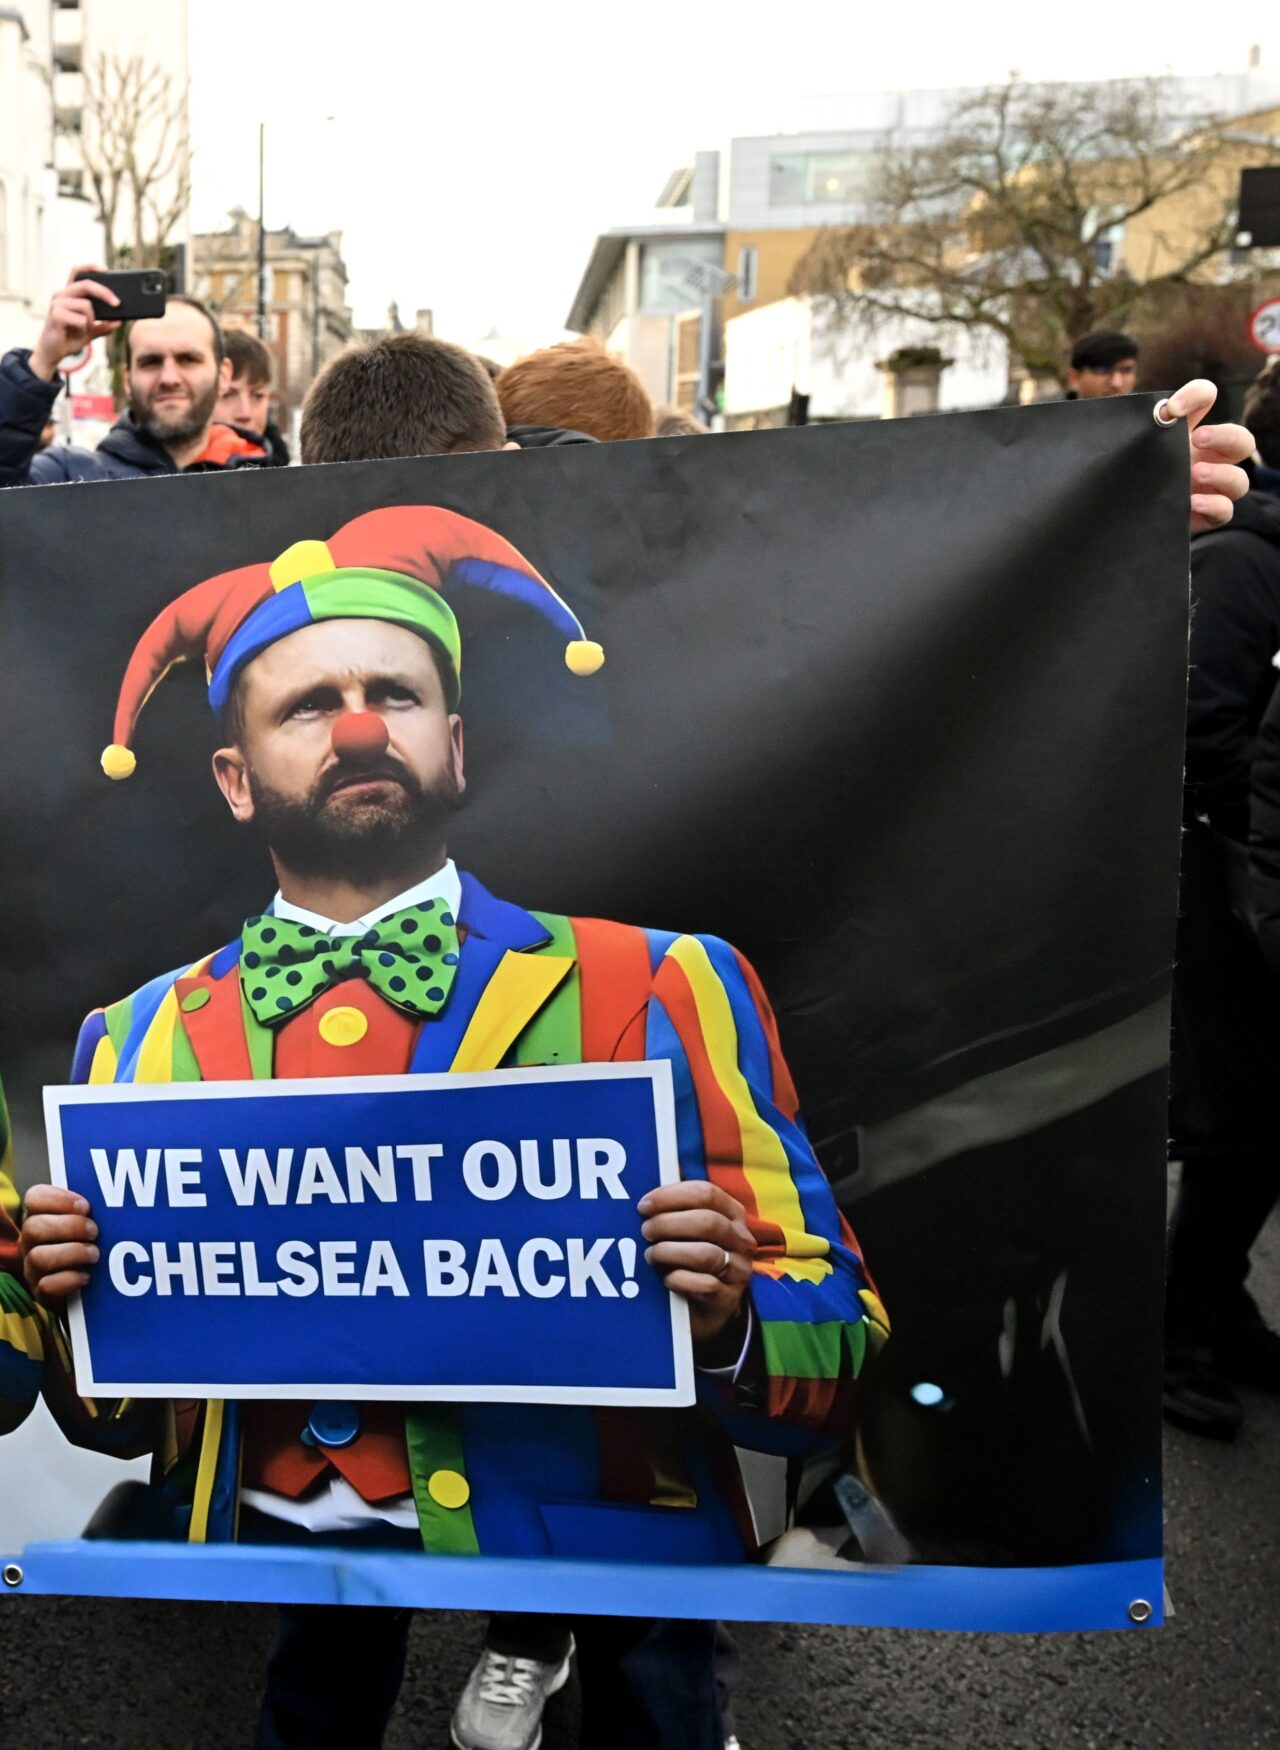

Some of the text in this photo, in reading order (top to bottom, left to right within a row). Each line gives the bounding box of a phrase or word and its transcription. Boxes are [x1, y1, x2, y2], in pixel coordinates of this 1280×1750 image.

[89, 1138, 630, 1208] WE WANT OUR
[108, 1237, 639, 1299] CHELSEA BACK!
